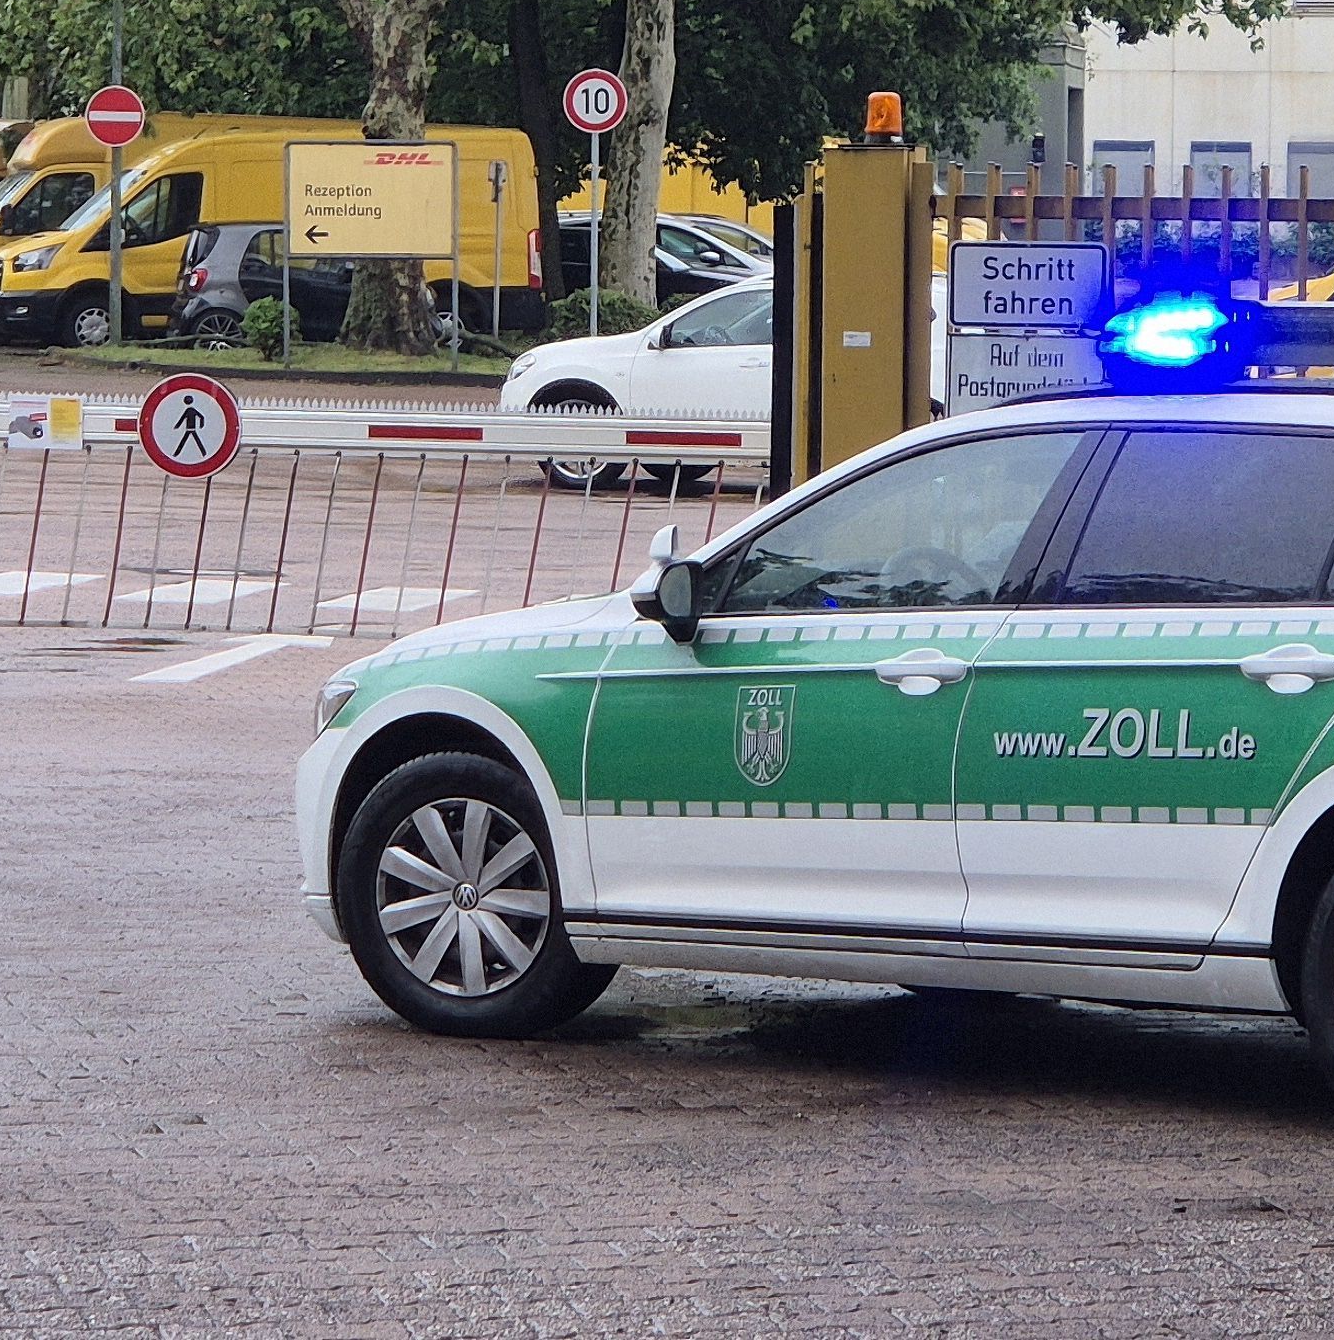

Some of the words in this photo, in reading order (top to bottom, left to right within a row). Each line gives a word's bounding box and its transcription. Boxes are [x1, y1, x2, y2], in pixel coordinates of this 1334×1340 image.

[581, 87, 610, 115] 10
[374, 152, 432, 166] DHL
[304, 183, 373, 200] Rezeption
[304, 203, 383, 220] Anmeldung
[982, 255, 1076, 282] Schritt
[983, 289, 1074, 316] fahren
[989, 342, 1020, 367] Auf
[1028, 346, 1064, 368] dem
[747, 688, 783, 706] ZOLL
[993, 707, 1258, 761] www.ZOLL.de
